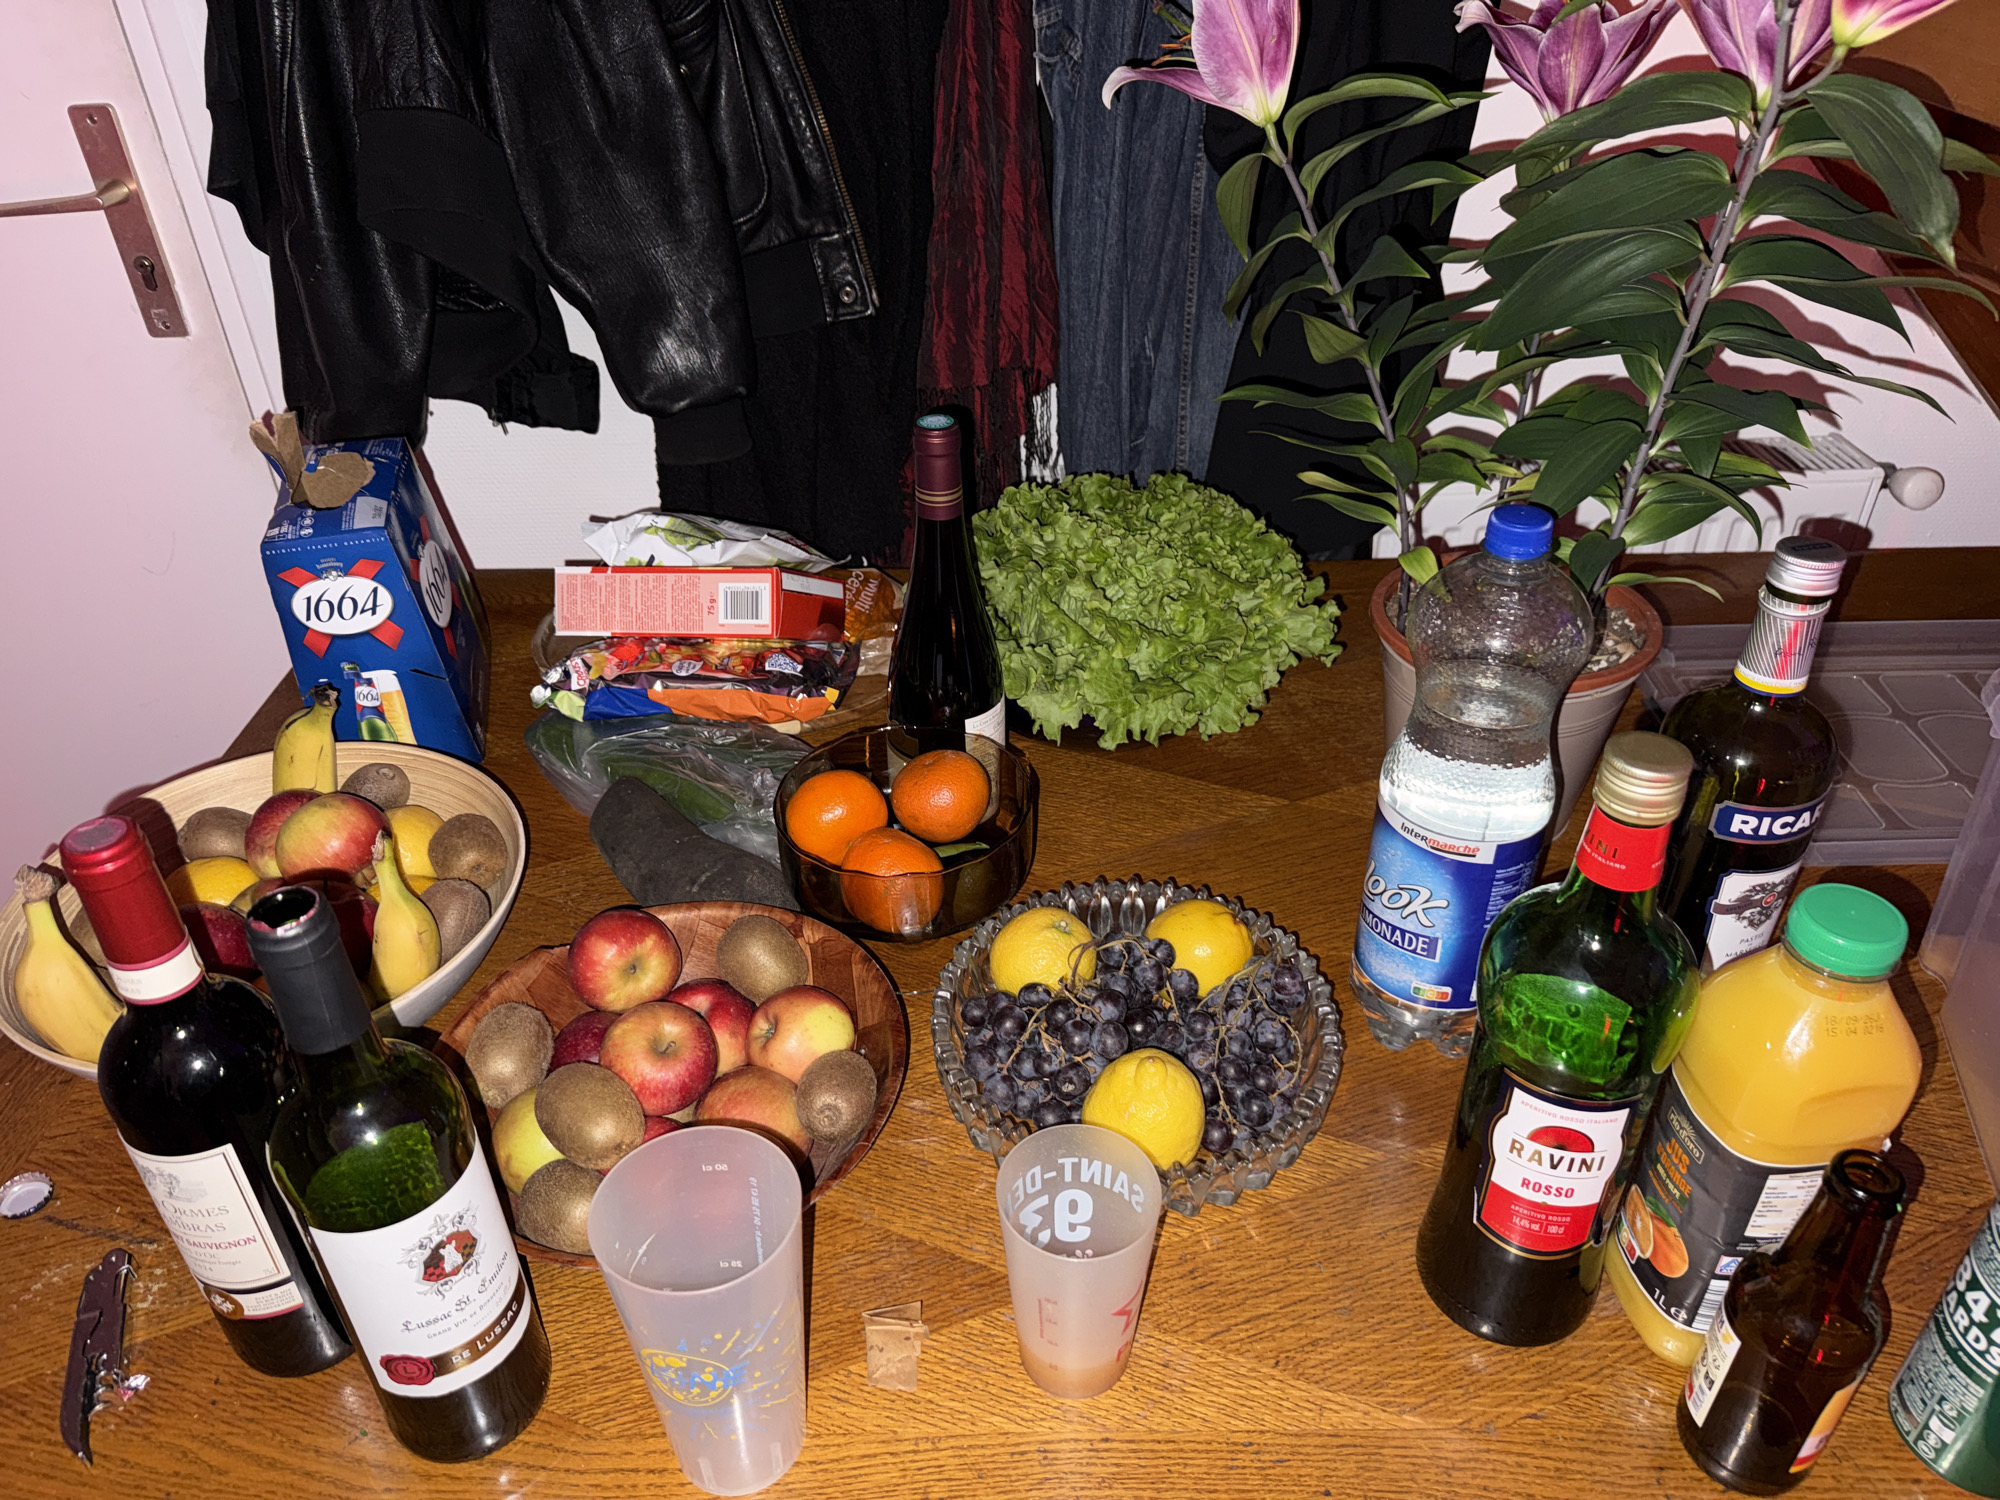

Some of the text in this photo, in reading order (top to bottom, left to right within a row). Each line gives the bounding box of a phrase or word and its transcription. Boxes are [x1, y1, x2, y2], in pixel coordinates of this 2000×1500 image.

[265, 537, 385, 555] ORIGINE FRANCE GARANTIE
[425, 544, 447, 621] 1664
[303, 585, 384, 625] 1664
[356, 689, 380, 703] 1664
[1591, 851, 1626, 870] ITALIANO
[1521, 1100, 1619, 1125] APERITIVO ROSSO ITALIANO
[1508, 1138, 1606, 1173] RAVINI
[1666, 1138, 1690, 1174] JUS
[1656, 1141, 1692, 1199] D'ORANGE
[1520, 1177, 1575, 1199] ROSSO
[161, 1200, 230, 1218] ORMES
[1511, 1204, 1546, 1220] APERITIVO
[1547, 1225, 1559, 1234] 100
[185, 1235, 258, 1250] SAUVIGNON
[427, 1327, 452, 1339] GRAND
[454, 1318, 468, 1328] VIN
[478, 1281, 504, 1311] BORDEAUX
[1652, 1287, 1666, 1311] 1L
[400, 1310, 453, 1334] Lussac
[451, 1300, 518, 1365] DE LUSSAC
